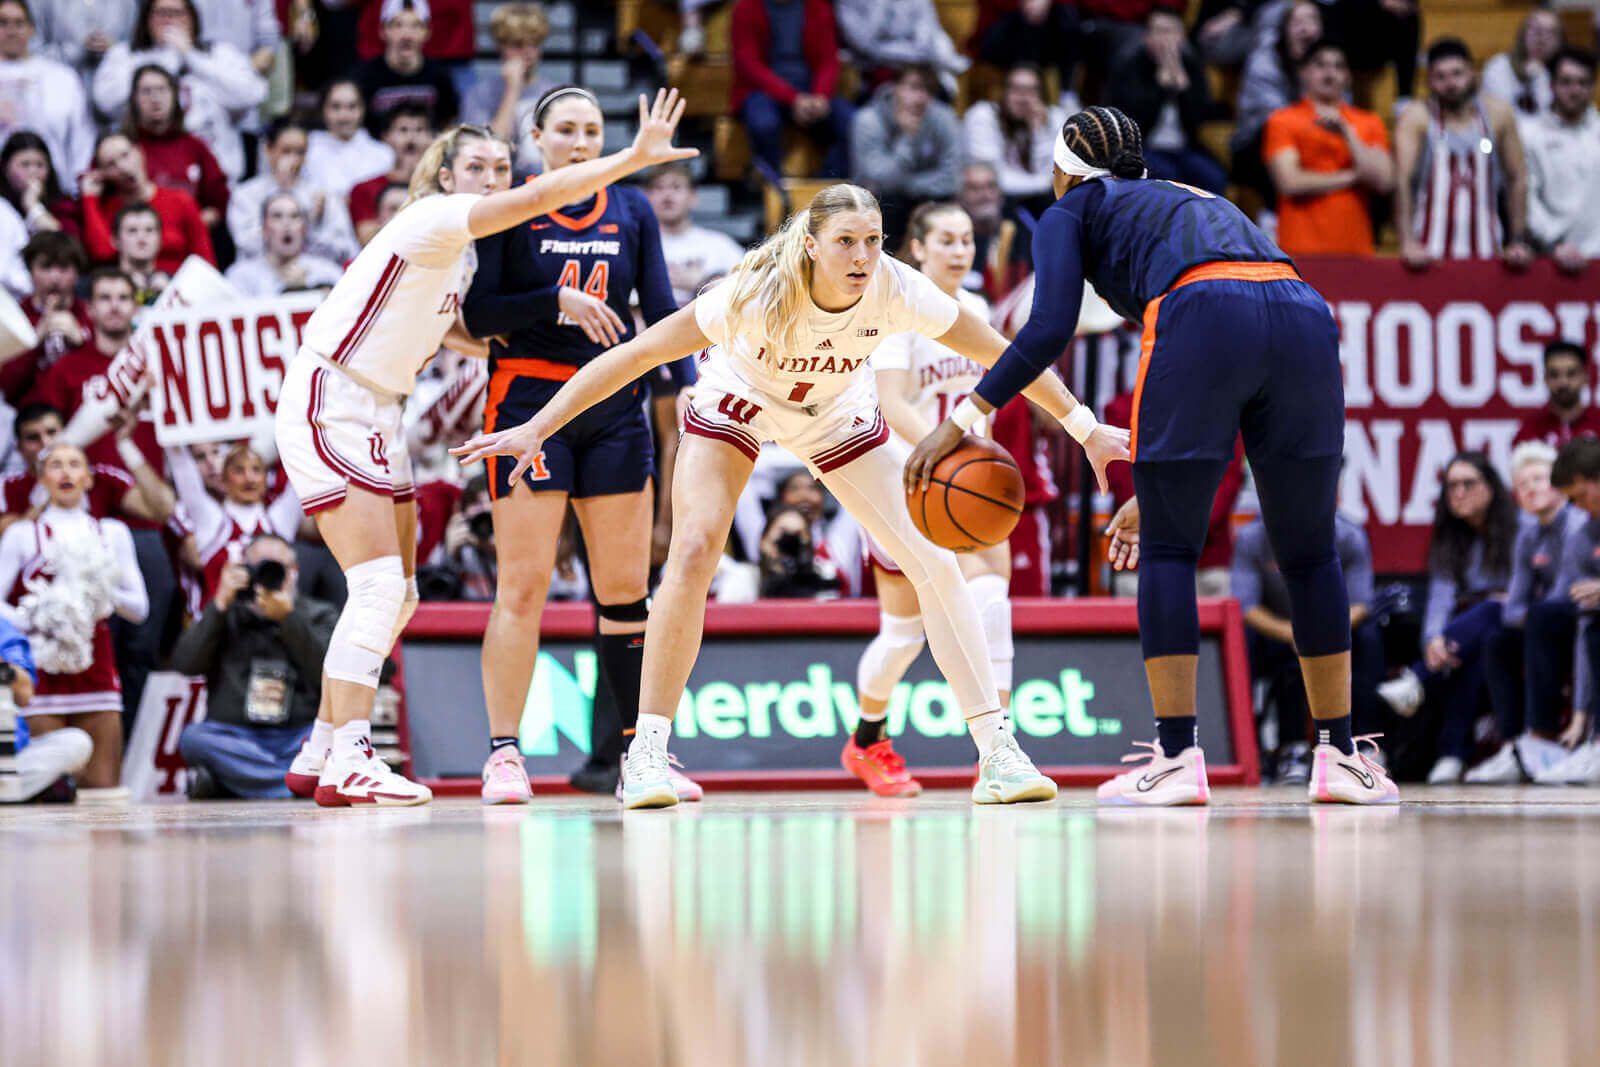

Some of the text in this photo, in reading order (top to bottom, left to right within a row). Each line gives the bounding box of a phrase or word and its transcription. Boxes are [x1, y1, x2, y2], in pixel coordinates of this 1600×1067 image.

[558, 259, 610, 302] 44
[152, 310, 317, 426] NOIS
[787, 381, 815, 403] 1
